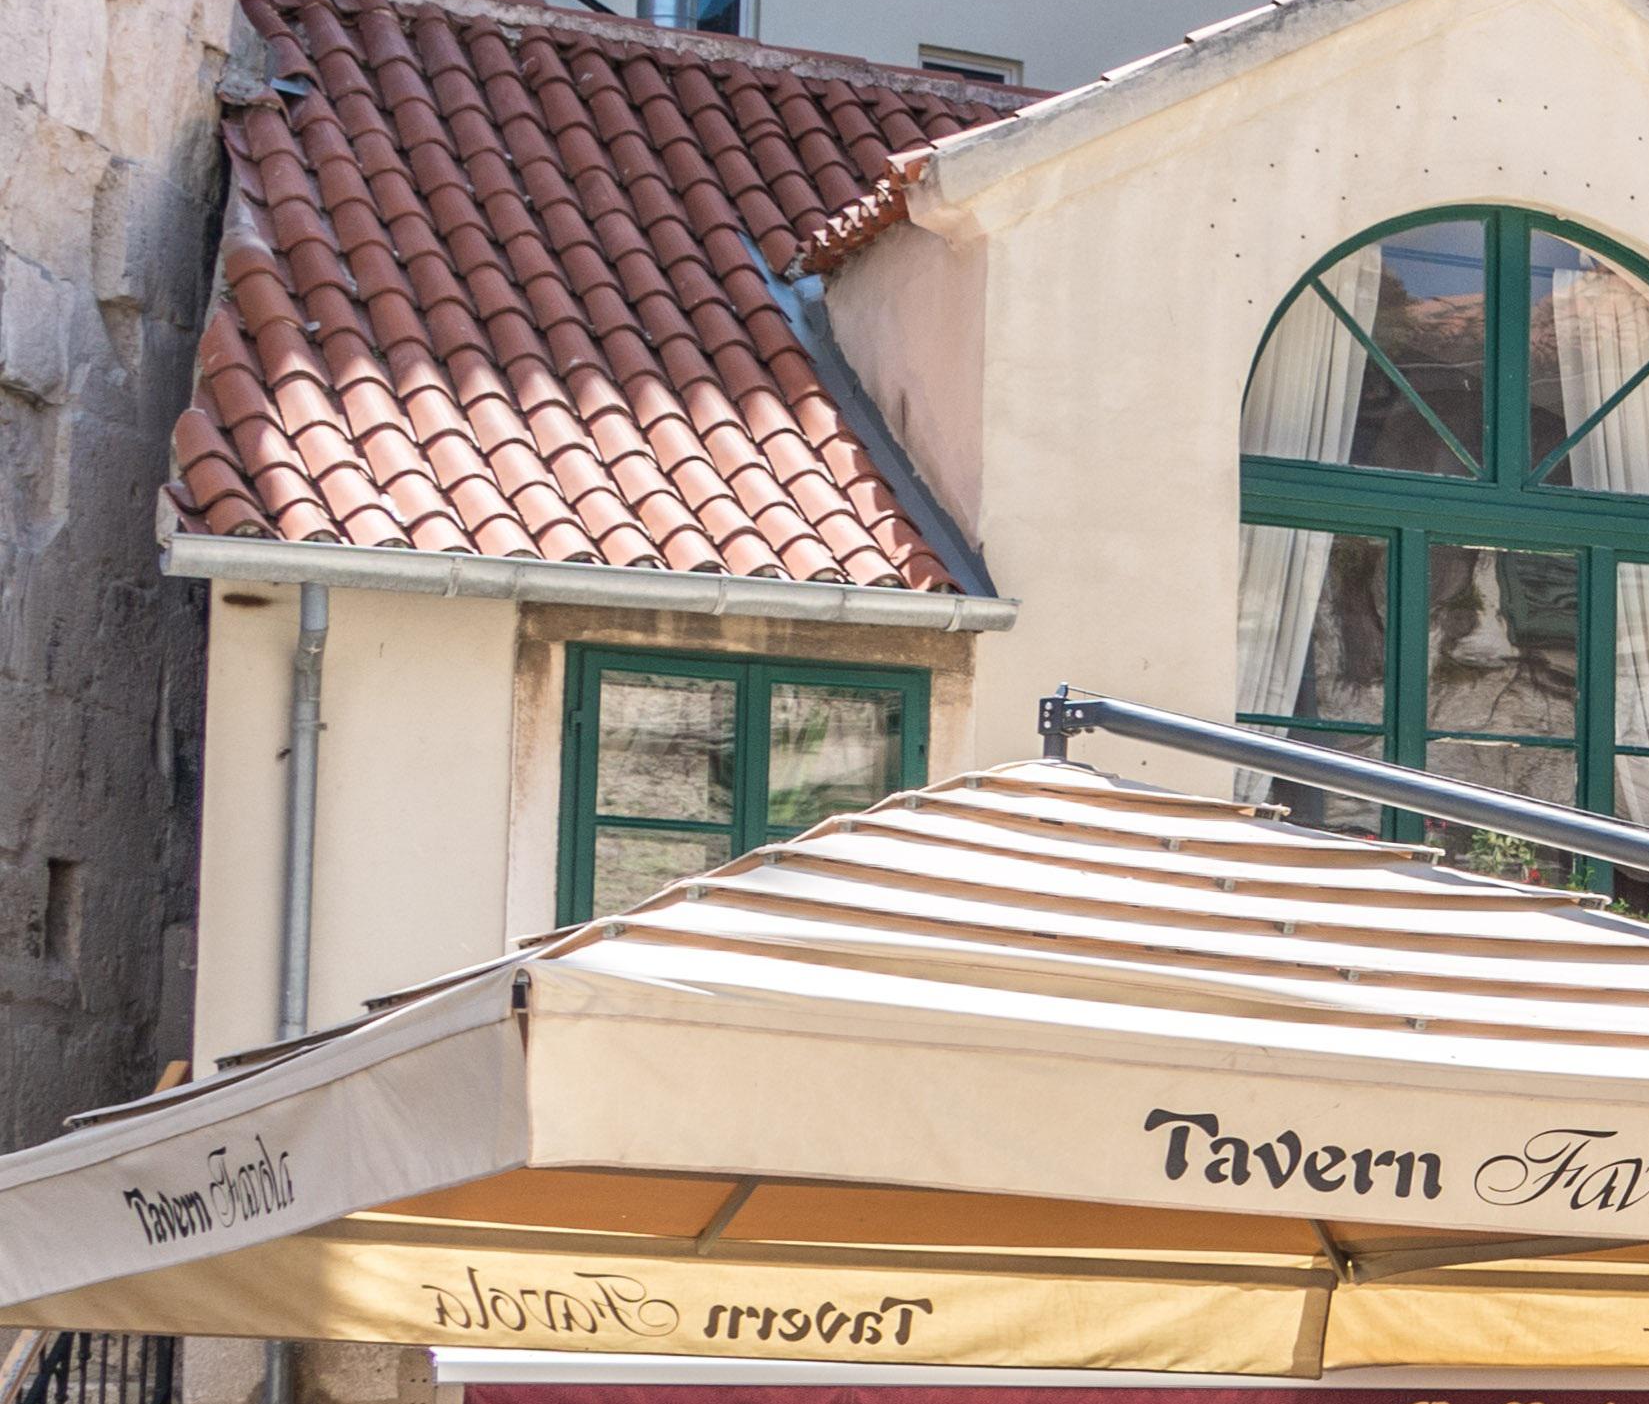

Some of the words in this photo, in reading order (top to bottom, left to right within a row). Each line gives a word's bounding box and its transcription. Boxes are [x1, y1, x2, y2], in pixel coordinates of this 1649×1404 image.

[124, 1188, 213, 1246] Tavern
[208, 1134, 296, 1231] Favola
[1144, 1107, 1444, 1200] Tavern
